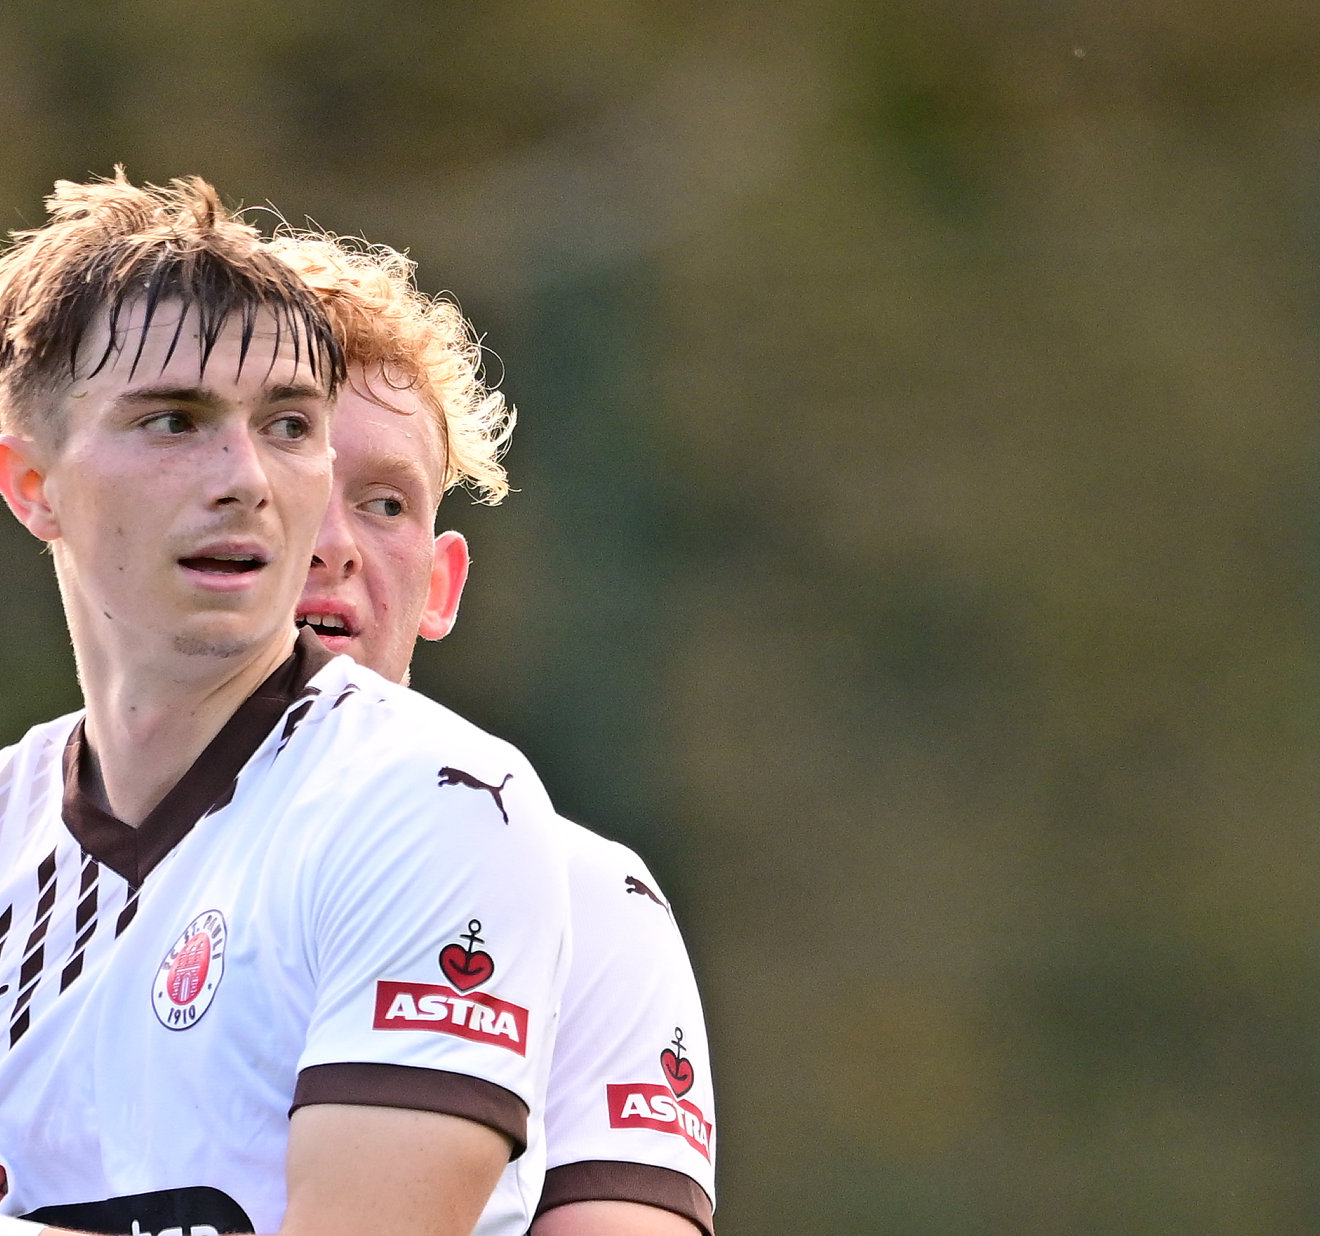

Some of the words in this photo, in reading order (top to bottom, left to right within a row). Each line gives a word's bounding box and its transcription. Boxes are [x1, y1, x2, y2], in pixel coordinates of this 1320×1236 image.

[167, 1004, 197, 1025] 1910
[384, 992, 520, 1042] ASTRA
[620, 1092, 709, 1156] ASTRA
